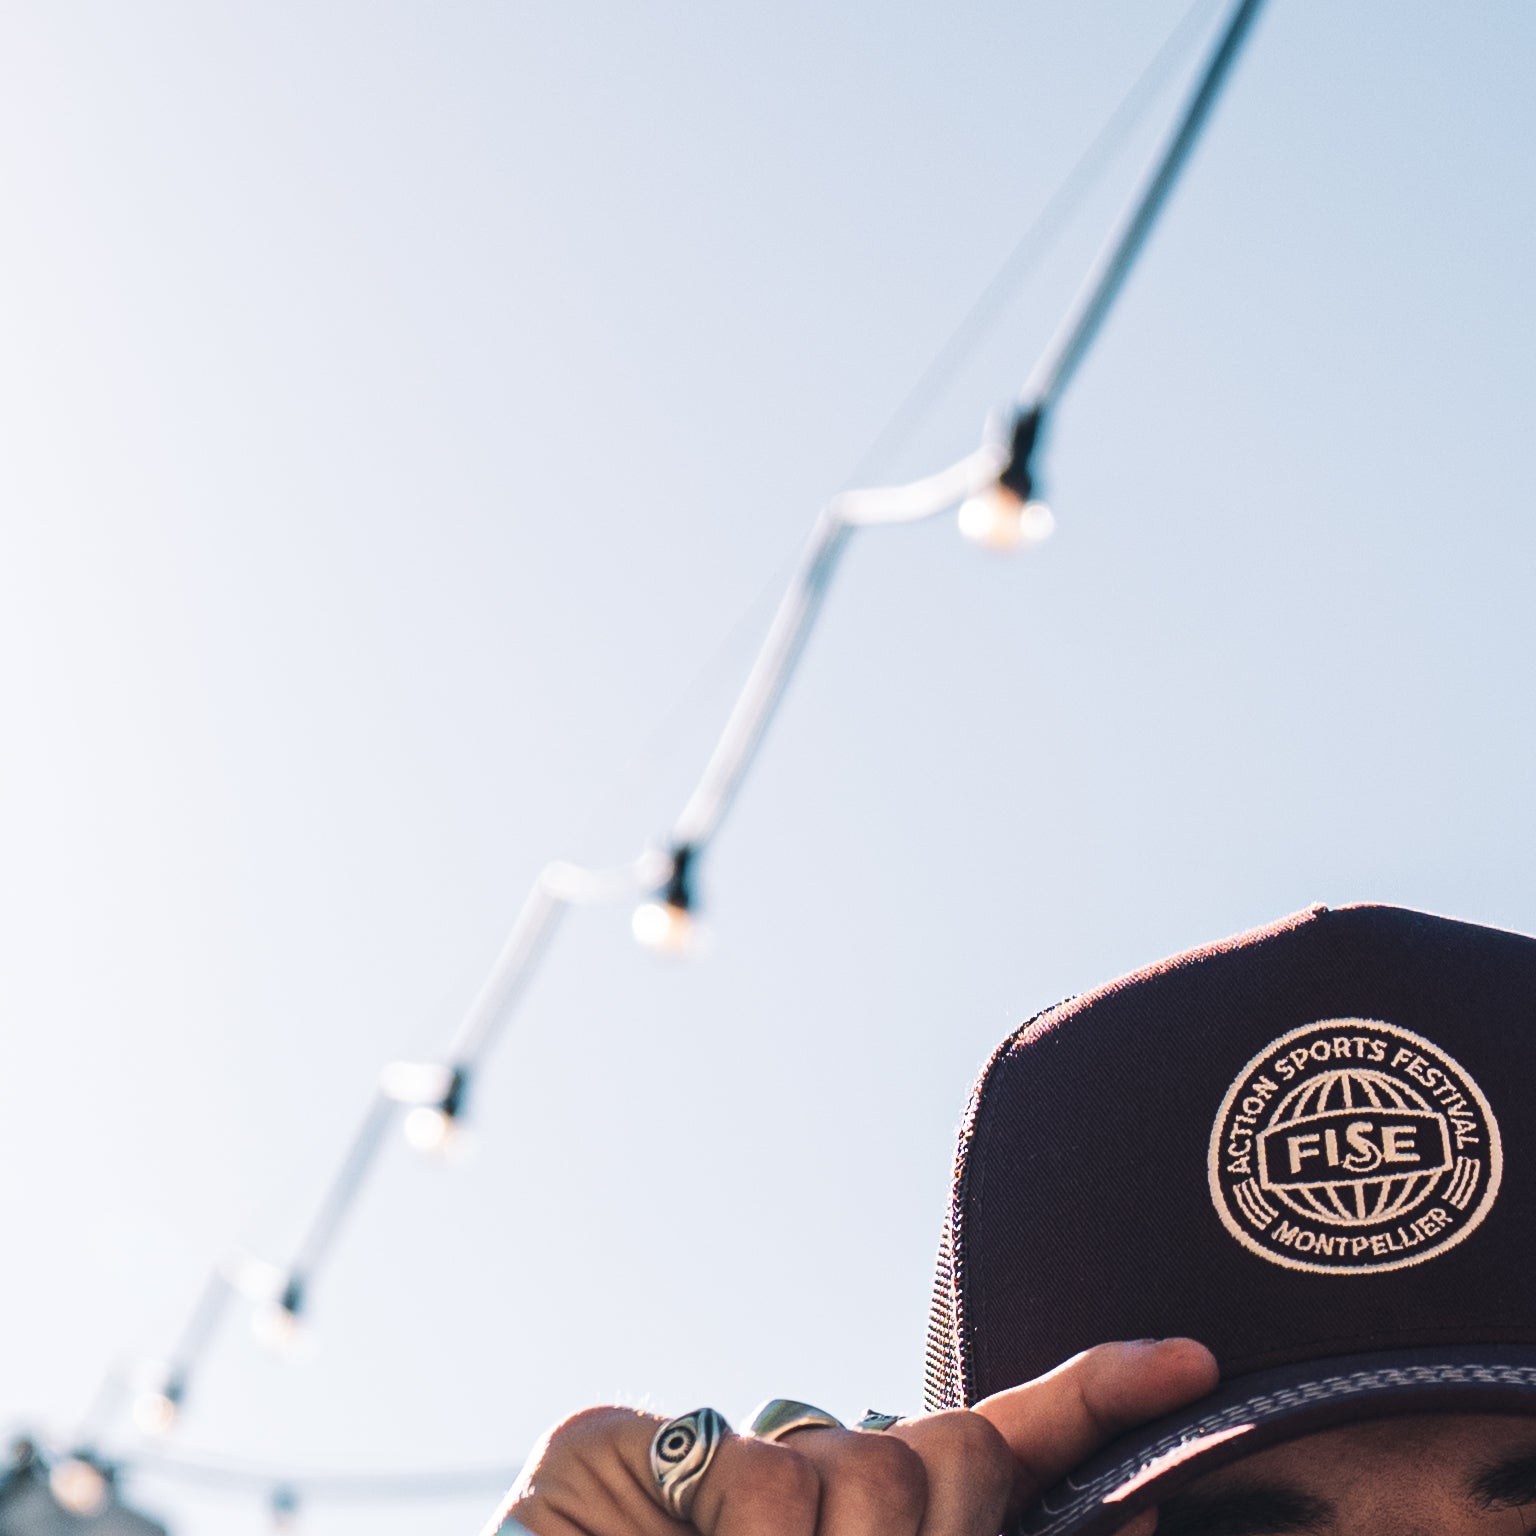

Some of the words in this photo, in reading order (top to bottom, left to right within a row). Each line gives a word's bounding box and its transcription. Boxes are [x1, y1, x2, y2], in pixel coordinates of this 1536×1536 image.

[1227, 1075, 1279, 1174] ACTION
[1274, 1036, 1388, 1081] SPORTS
[1390, 1047, 1480, 1150] FESTIVAL
[1287, 1121, 1421, 1174] FISE
[1271, 1207, 1454, 1256] MONTPELLIER
